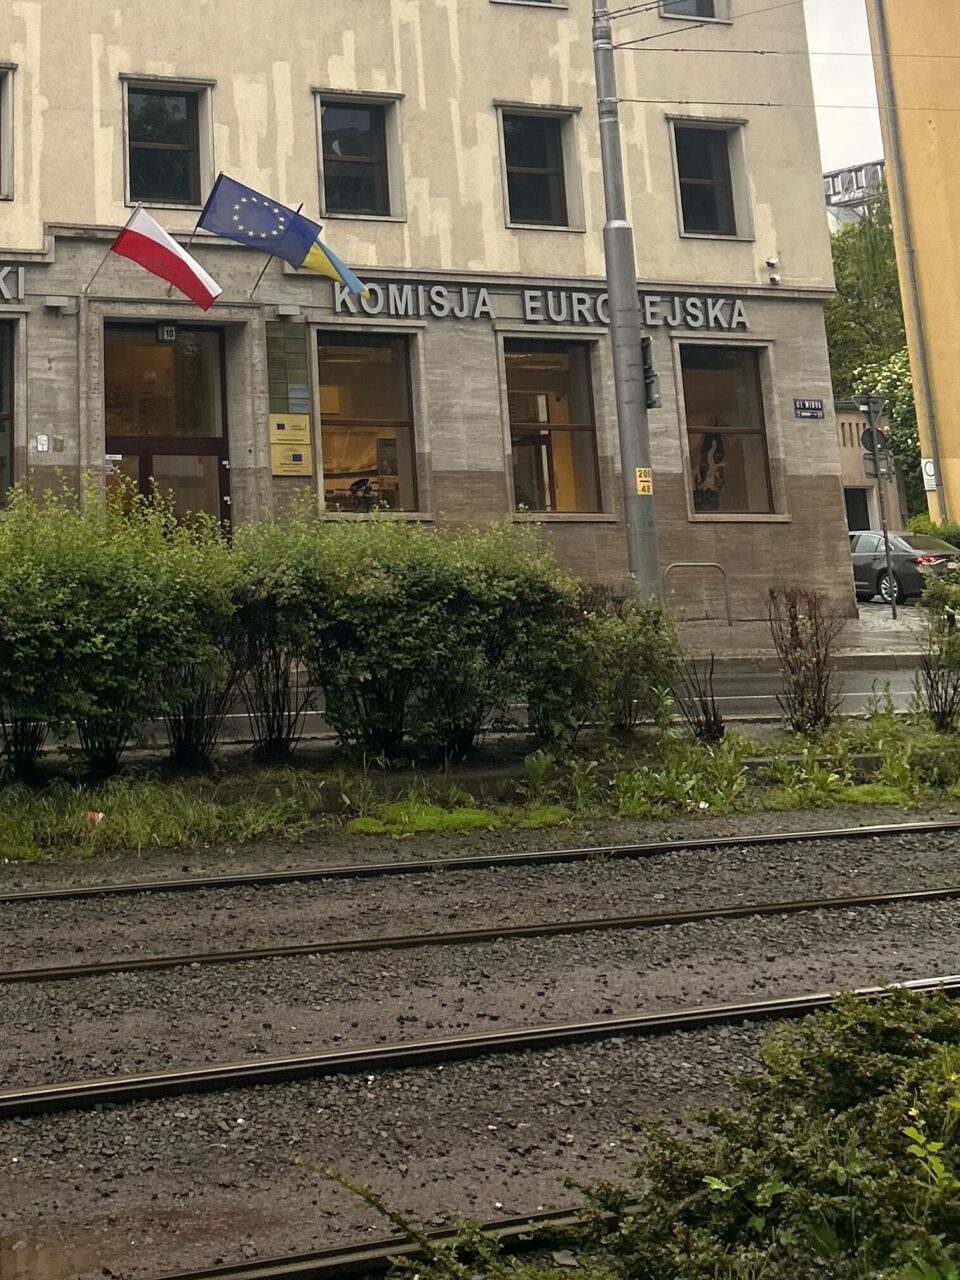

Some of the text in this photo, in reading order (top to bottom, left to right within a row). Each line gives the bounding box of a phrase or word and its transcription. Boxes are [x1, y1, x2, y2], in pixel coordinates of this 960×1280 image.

[334, 281, 751, 329] KOMISJA EUROEJSKA
[165, 328, 174, 338] 10
